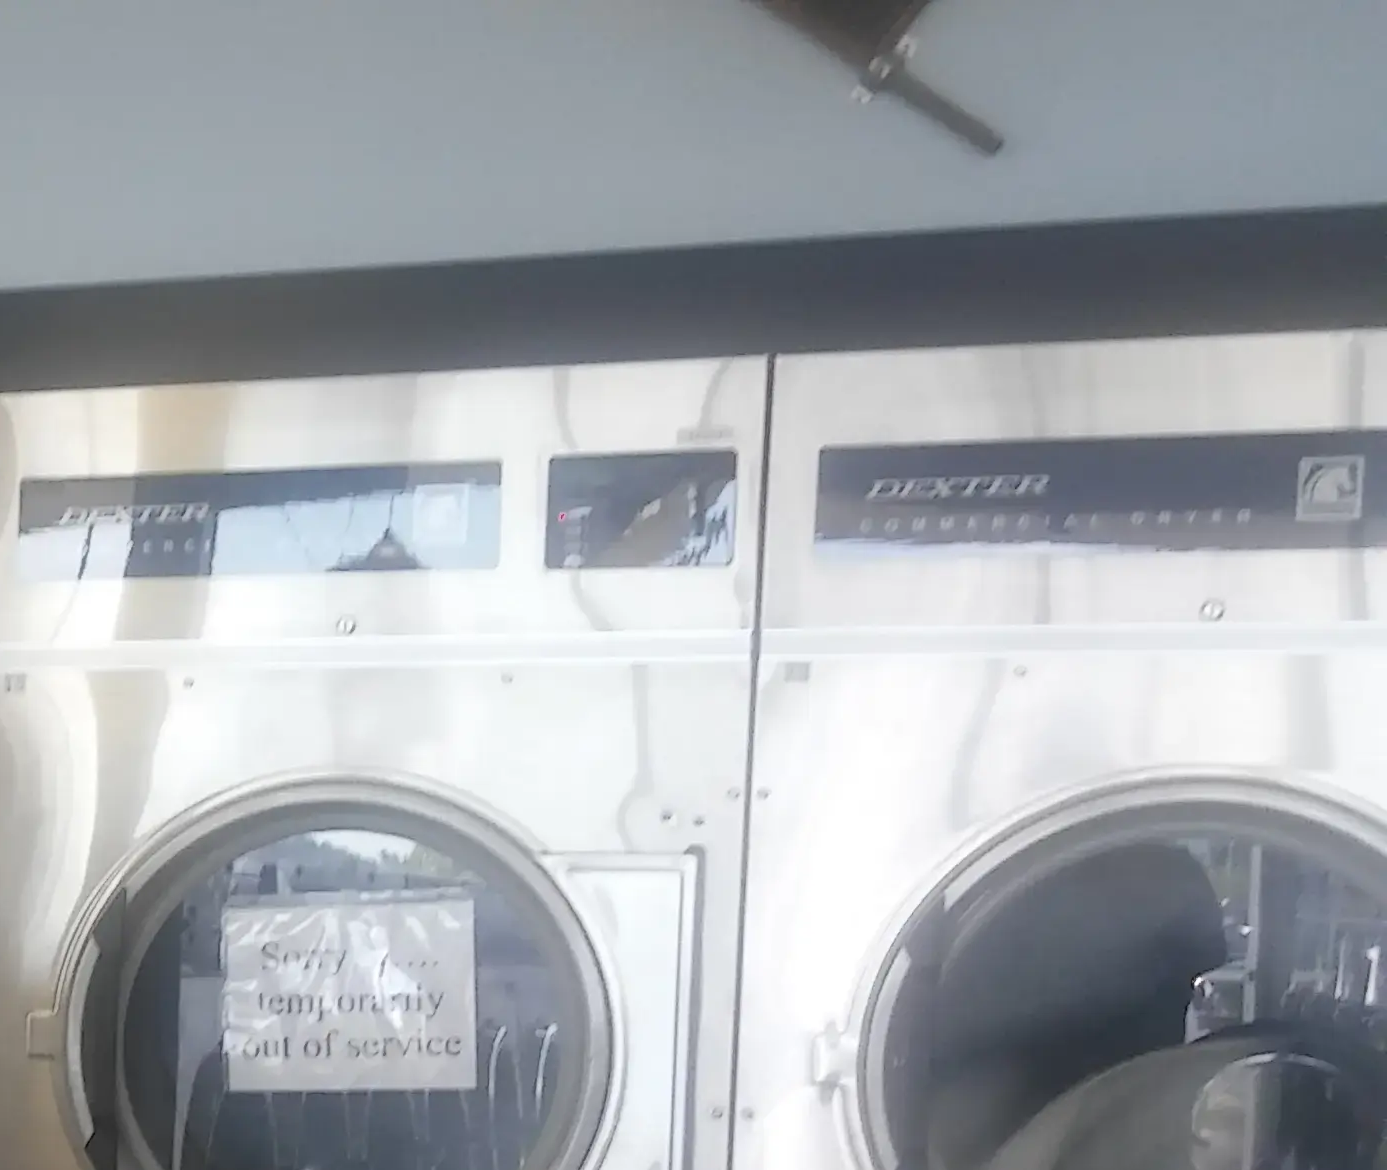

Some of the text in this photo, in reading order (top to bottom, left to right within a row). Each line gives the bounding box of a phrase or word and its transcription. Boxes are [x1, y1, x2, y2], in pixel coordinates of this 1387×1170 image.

[865, 474, 1051, 501] DEXTER
[58, 503, 210, 526] DEXTER
[1130, 507, 1252, 526] DRYER
[241, 1028, 463, 1060] out of service
